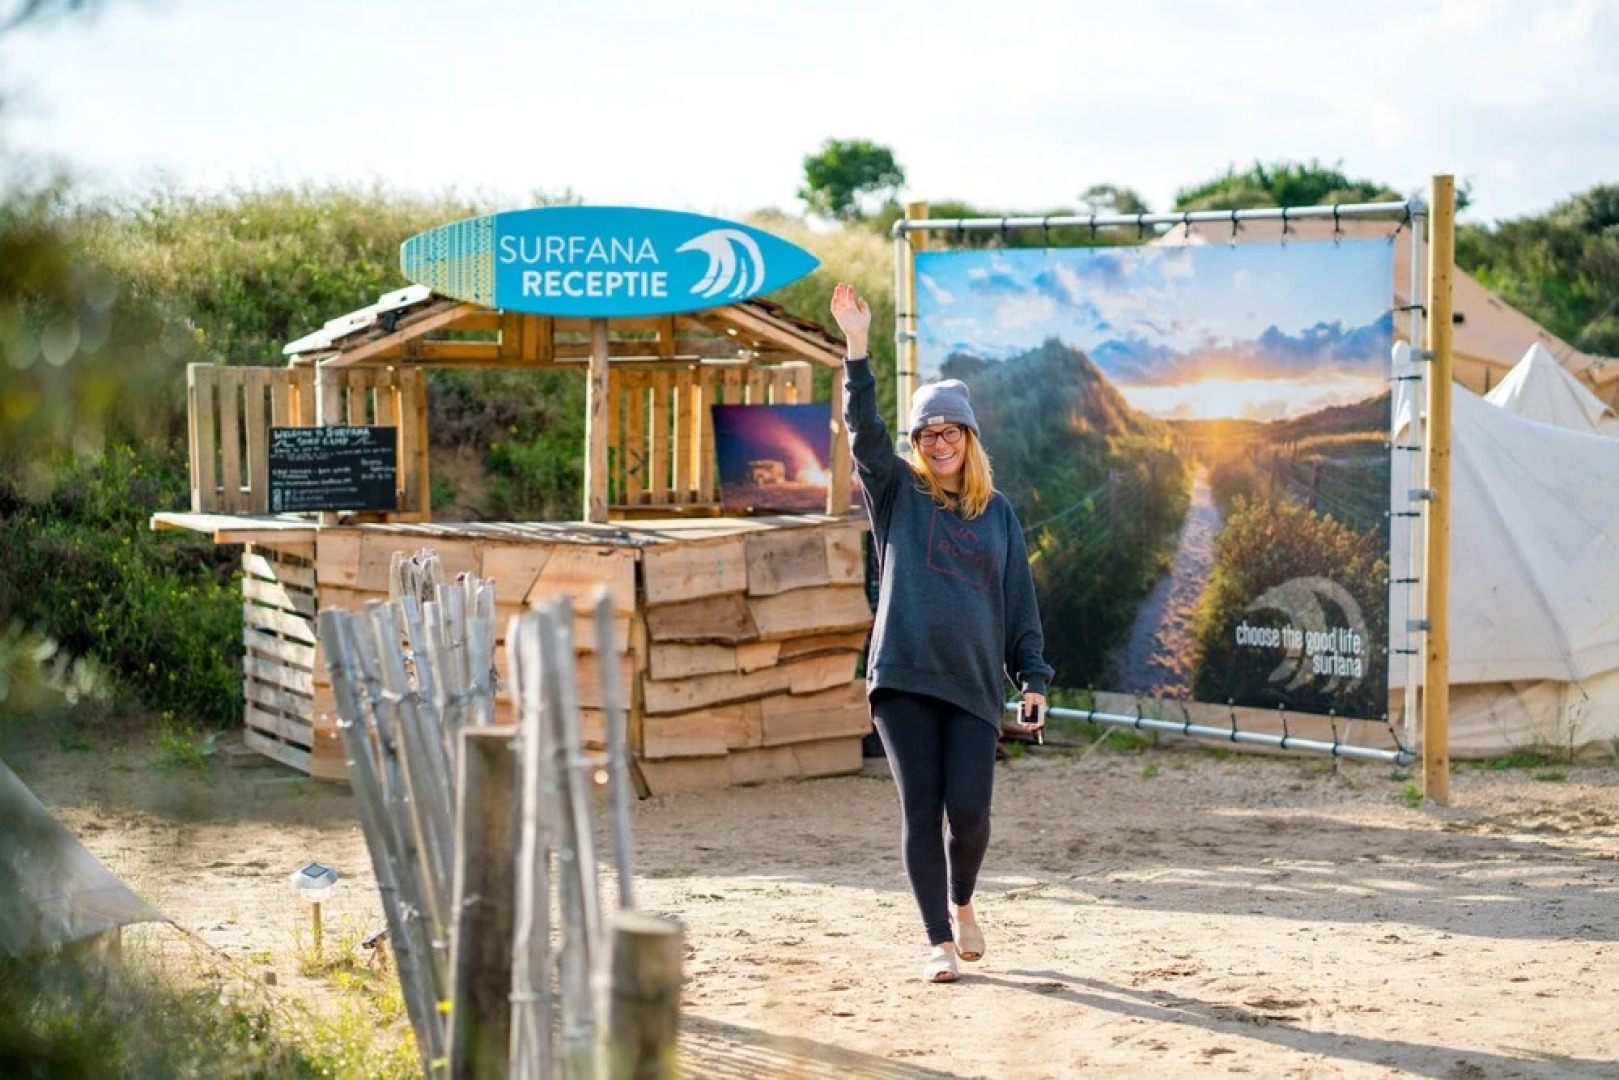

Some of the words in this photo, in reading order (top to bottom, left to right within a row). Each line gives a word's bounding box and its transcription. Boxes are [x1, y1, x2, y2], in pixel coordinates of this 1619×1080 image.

[499, 235, 659, 264] SURFANA
[522, 271, 668, 297] RECEPTIE
[322, 437, 349, 445] CAMP
[1236, 620, 1280, 647] choose
[1282, 623, 1303, 648] the
[1305, 627, 1336, 655] good
[1338, 627, 1365, 655] life.
[1312, 651, 1362, 677] surfana
